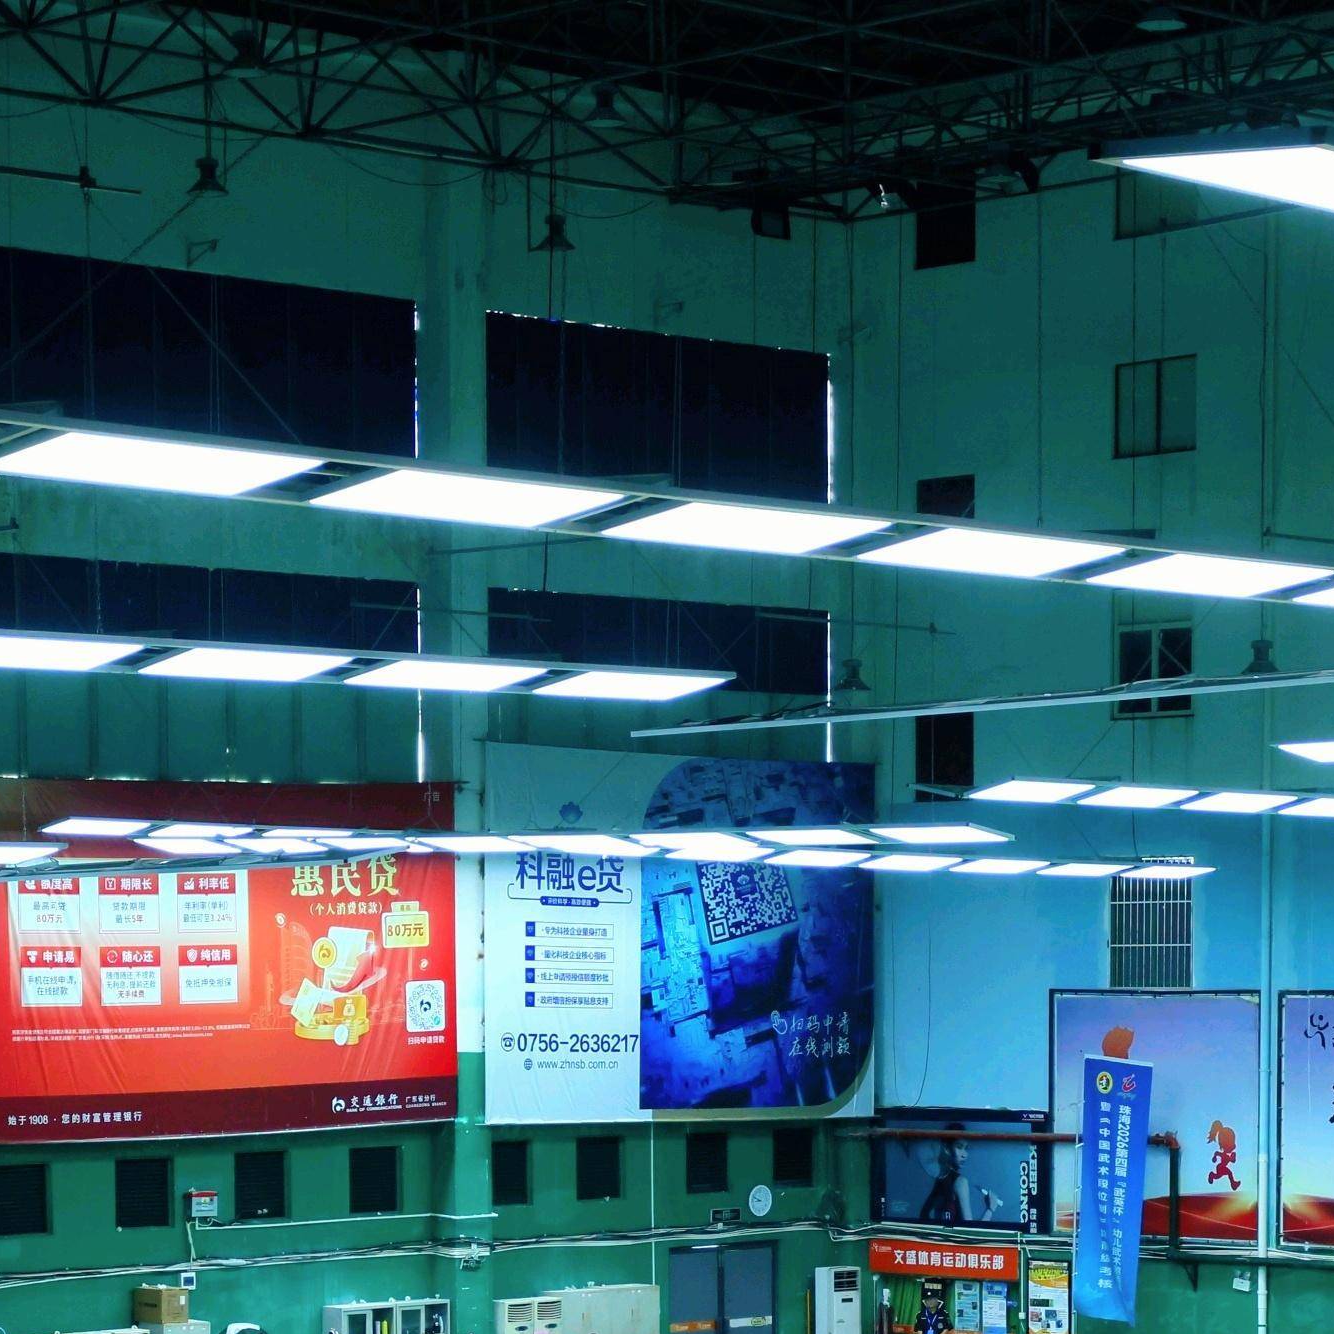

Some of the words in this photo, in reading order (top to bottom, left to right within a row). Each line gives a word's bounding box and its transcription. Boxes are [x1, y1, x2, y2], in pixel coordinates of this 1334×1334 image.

[515, 851, 625, 893] 科融e贷
[120, 877, 153, 891] 期限长
[198, 877, 230, 890] 利率低
[386, 923, 424, 938] 80万元
[517, 1033, 639, 1053] 0756-2636217
[349, 1094, 399, 1108] 交通银行
[893, 1249, 1005, 1270] 文盛体育运动俱乐部
